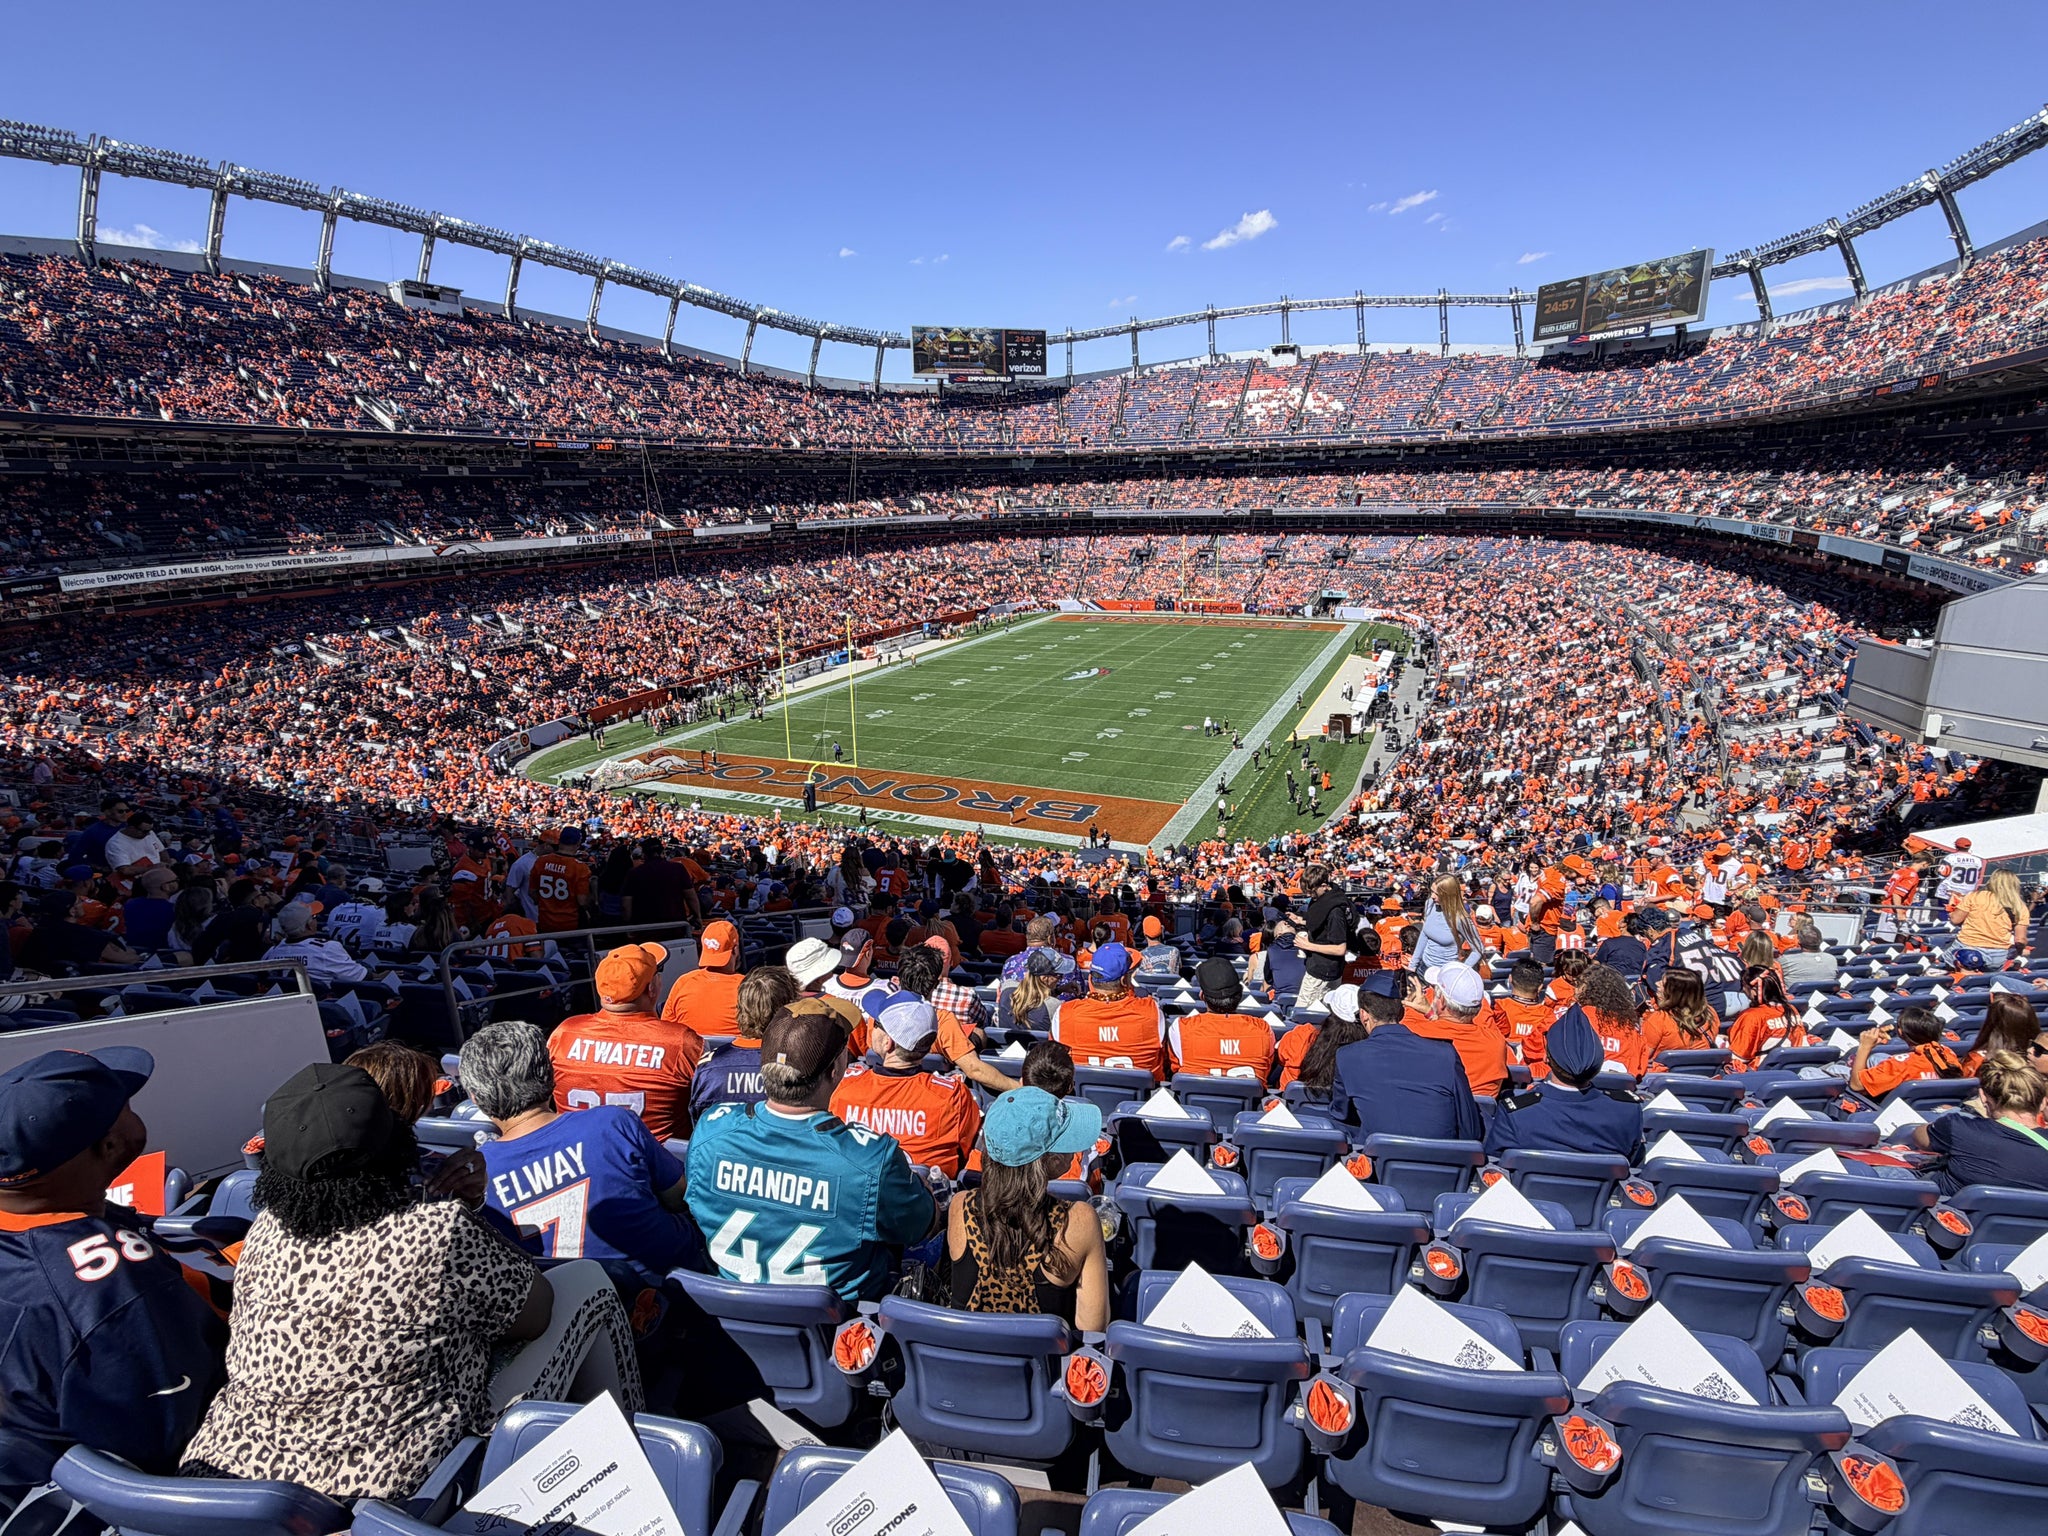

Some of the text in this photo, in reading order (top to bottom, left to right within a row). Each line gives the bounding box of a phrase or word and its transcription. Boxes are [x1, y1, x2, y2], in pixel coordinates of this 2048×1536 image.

[1544, 298, 1577, 314] 24:57
[1540, 321, 1577, 335] BUD LIGHT
[1588, 326, 1645, 340] EMPOWER FIELD
[1008, 363, 1042, 372] verizon
[576, 532, 646, 545] FAN ISSUES? TEXT
[63, 577, 96, 588] Welcome
[106, 572, 145, 583] EMPOWER
[145, 569, 167, 579] FIELD
[168, 568, 178, 576] AT
[180, 566, 200, 575] MILE
[201, 564, 224, 574] HIGH,
[225, 562, 245, 571] home
[246, 561, 253, 569] to
[254, 562, 270, 570] your
[271, 558, 303, 567] DENVER
[303, 555, 339, 565] BRONCOS
[1930, 566, 1950, 581] EMPOWER
[1061, 751, 1090, 763] 10
[544, 861, 566, 874] MILLER
[1951, 866, 1978, 885] 30
[538, 874, 569, 900] 58
[334, 913, 362, 923] WALKER
[878, 960, 899, 970] SURTAI
[1098, 1026, 1120, 1042] NIX
[1515, 1022, 1534, 1036] NIX
[567, 1038, 666, 1070] ATWATER
[1219, 1039, 1241, 1056] NIX
[727, 1072, 767, 1094] LYNC
[845, 1104, 927, 1136] MANNING
[492, 1141, 587, 1209] ELWAY
[716, 1159, 830, 1211] GRANDPA
[509, 1177, 591, 1258] 7
[66, 1227, 154, 1282] 58
[708, 1208, 828, 1286] 44
[540, 1457, 578, 1491] conoco
[542, 1461, 619, 1526] INSTRUCTIONS
[835, 1501, 872, 1536] conoco
[872, 1502, 918, 1536] CTIONS
